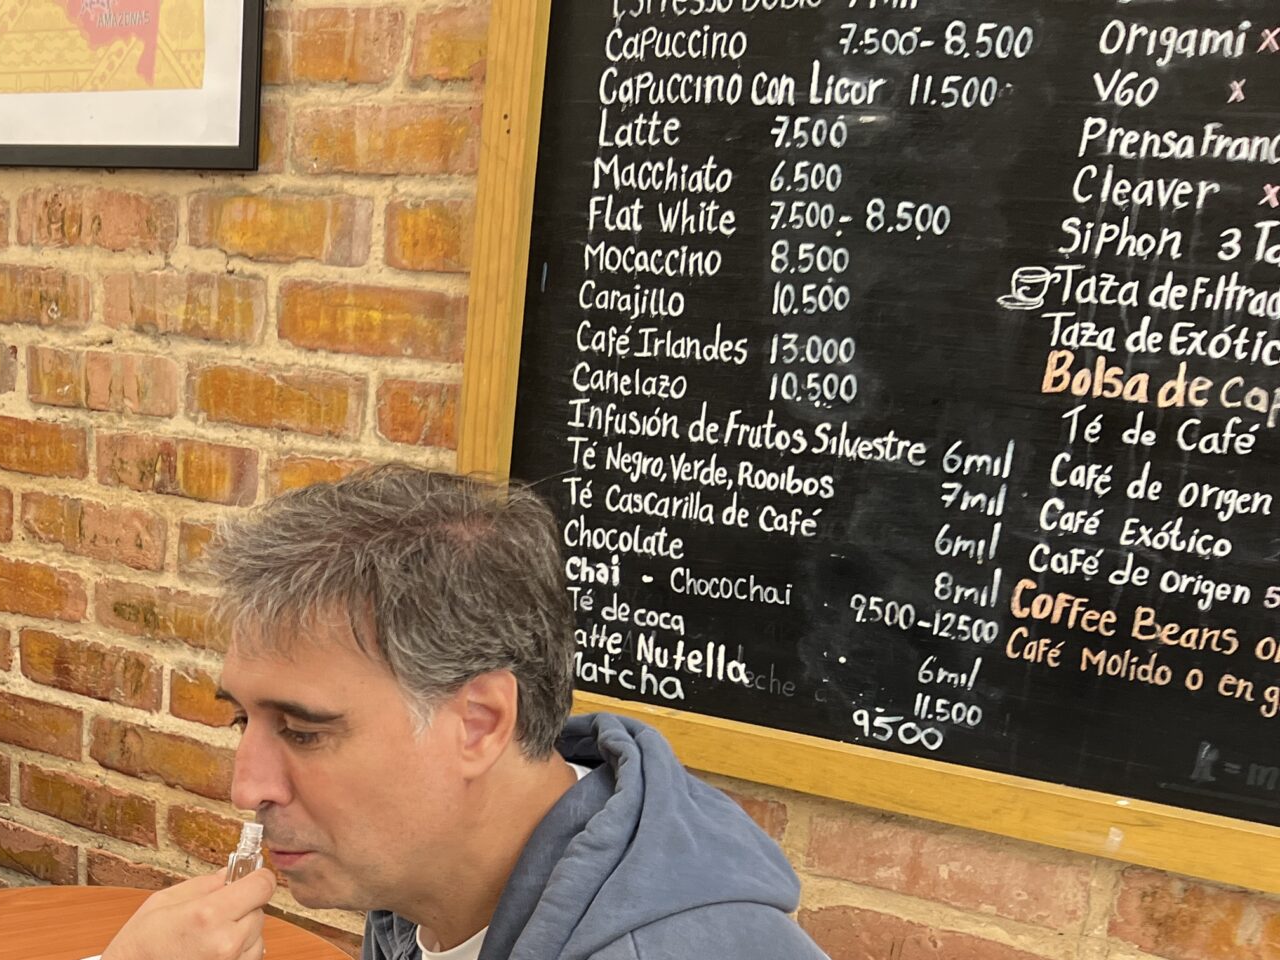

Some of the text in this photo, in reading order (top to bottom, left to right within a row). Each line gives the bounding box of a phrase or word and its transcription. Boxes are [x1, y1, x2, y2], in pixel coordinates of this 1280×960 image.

[1098, 19, 1252, 67] Origami
[810, 60, 886, 106] Licor
[909, 74, 999, 109] 11.500
[1092, 68, 1160, 107] V60
[599, 108, 848, 148] Latte 7.500
[1077, 116, 1195, 160] Prensa
[593, 154, 842, 194] Macchiato 6.500
[1072, 164, 1221, 210] Cleaver
[588, 196, 645, 234] Flat
[659, 198, 736, 235] White
[584, 240, 850, 277] Mocaccino 8.500
[1217, 227, 1242, 261] 3
[579, 281, 850, 320] Carajillo 10.500
[1054, 264, 1140, 307] Taza
[1148, 271, 1188, 310] de
[576, 321, 856, 365] Café Irlandes 13.000
[1041, 311, 1280, 366] Taza de Exótic
[572, 362, 857, 402] Canelazo 10.500
[1041, 350, 1150, 403] Bolsa
[1157, 361, 1214, 408] de
[567, 398, 680, 440] Infusión
[688, 402, 719, 445] de
[725, 410, 808, 456] Frutos
[813, 423, 926, 467] Silvestre
[1061, 403, 1260, 455] Té de Café
[567, 437, 598, 470] Té
[738, 461, 835, 499] Rooibos
[1127, 460, 1162, 500] de
[562, 477, 593, 508] Té
[605, 484, 715, 525] Cascarilla
[722, 491, 750, 528] de
[758, 505, 823, 537] Café
[564, 515, 685, 560] Chocolate
[1120, 517, 1232, 557] Exótico
[565, 554, 620, 587] Chai
[1108, 552, 1150, 586] de
[566, 586, 594, 611] Té
[601, 592, 630, 622] de
[1131, 605, 1240, 655] Beans
[1255, 636, 1280, 664] o
[574, 623, 623, 654] atte
[637, 632, 750, 684] Nutella
[914, 692, 983, 726] 11.500
[1080, 647, 1172, 686] Molido
[1185, 668, 1204, 691] o
[1218, 673, 1255, 702] en
